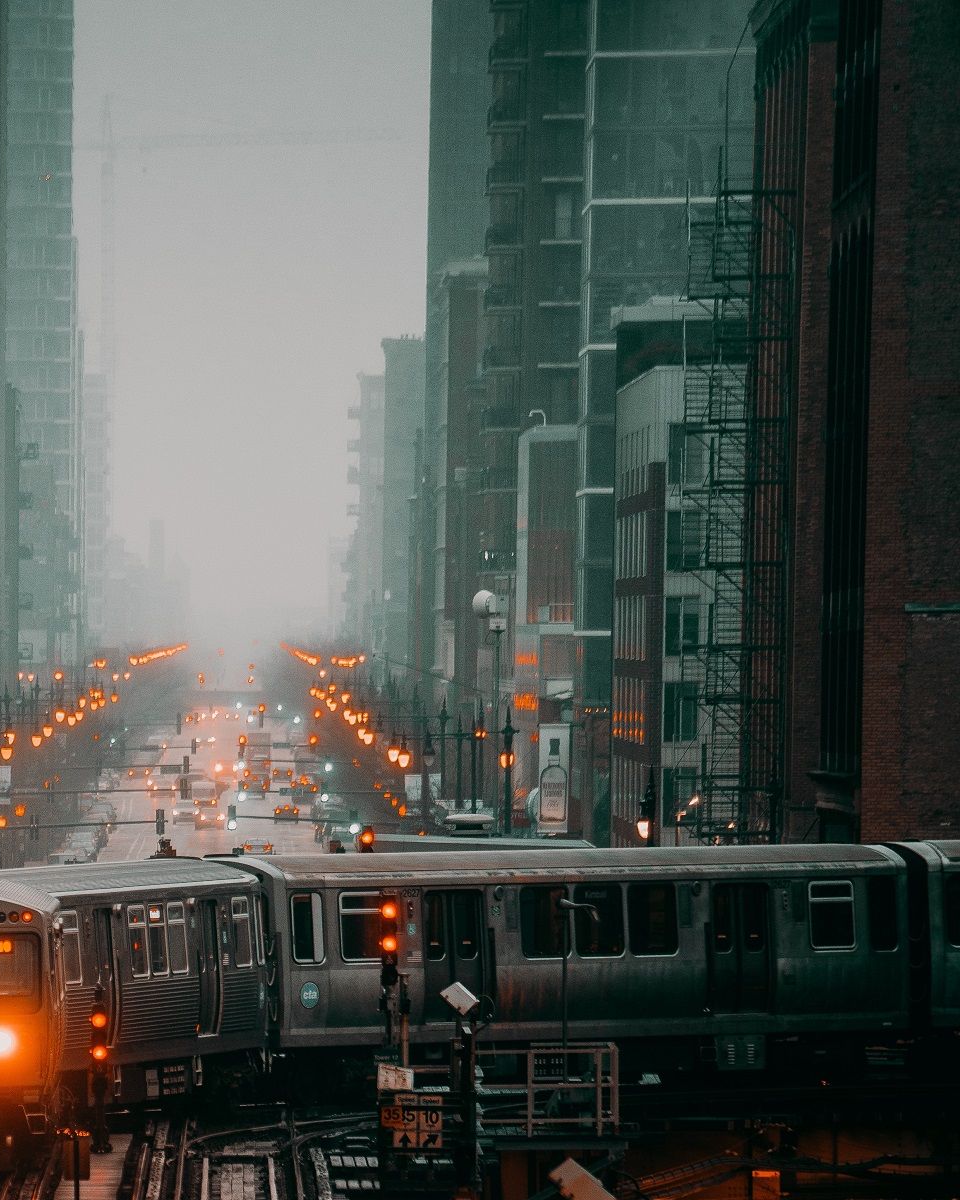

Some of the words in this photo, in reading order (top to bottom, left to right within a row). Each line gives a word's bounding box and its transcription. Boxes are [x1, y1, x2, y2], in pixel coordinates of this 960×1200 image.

[402, 888, 420, 897] 2627
[303, 990, 318, 1000] cta
[383, 1108, 401, 1121] 35
[422, 1111, 440, 1125] 10
